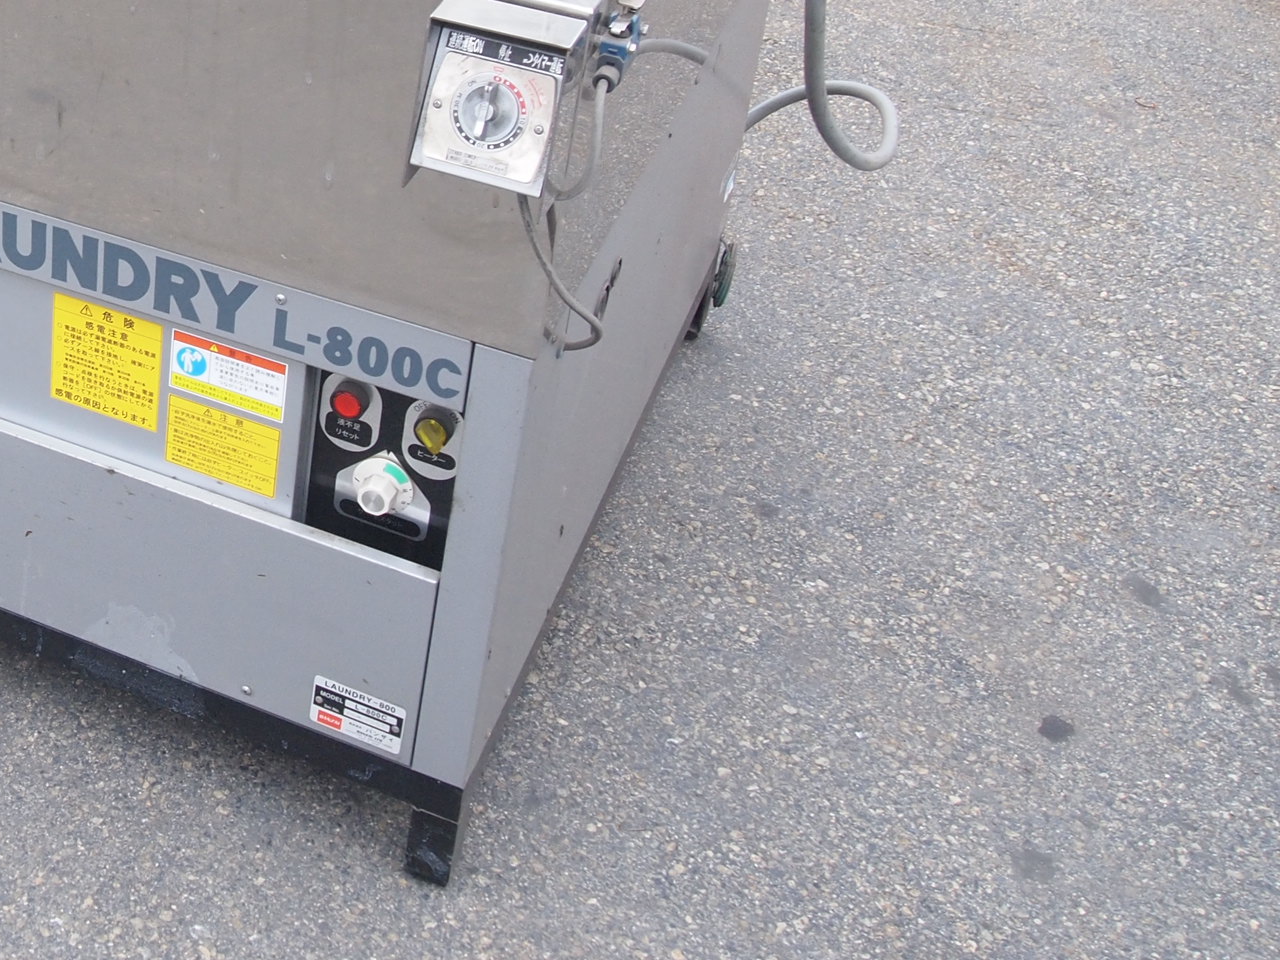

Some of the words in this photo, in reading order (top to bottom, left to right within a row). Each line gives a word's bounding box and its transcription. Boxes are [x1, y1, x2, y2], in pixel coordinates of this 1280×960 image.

[102, 310, 135, 330] 危険
[85, 320, 128, 341] 感電注意
[272, 308, 463, 400] L-800C
[55, 387, 152, 427] 感電の原因となります。
[336, 427, 360, 441] リセット
[319, 689, 344, 704] MODEL
